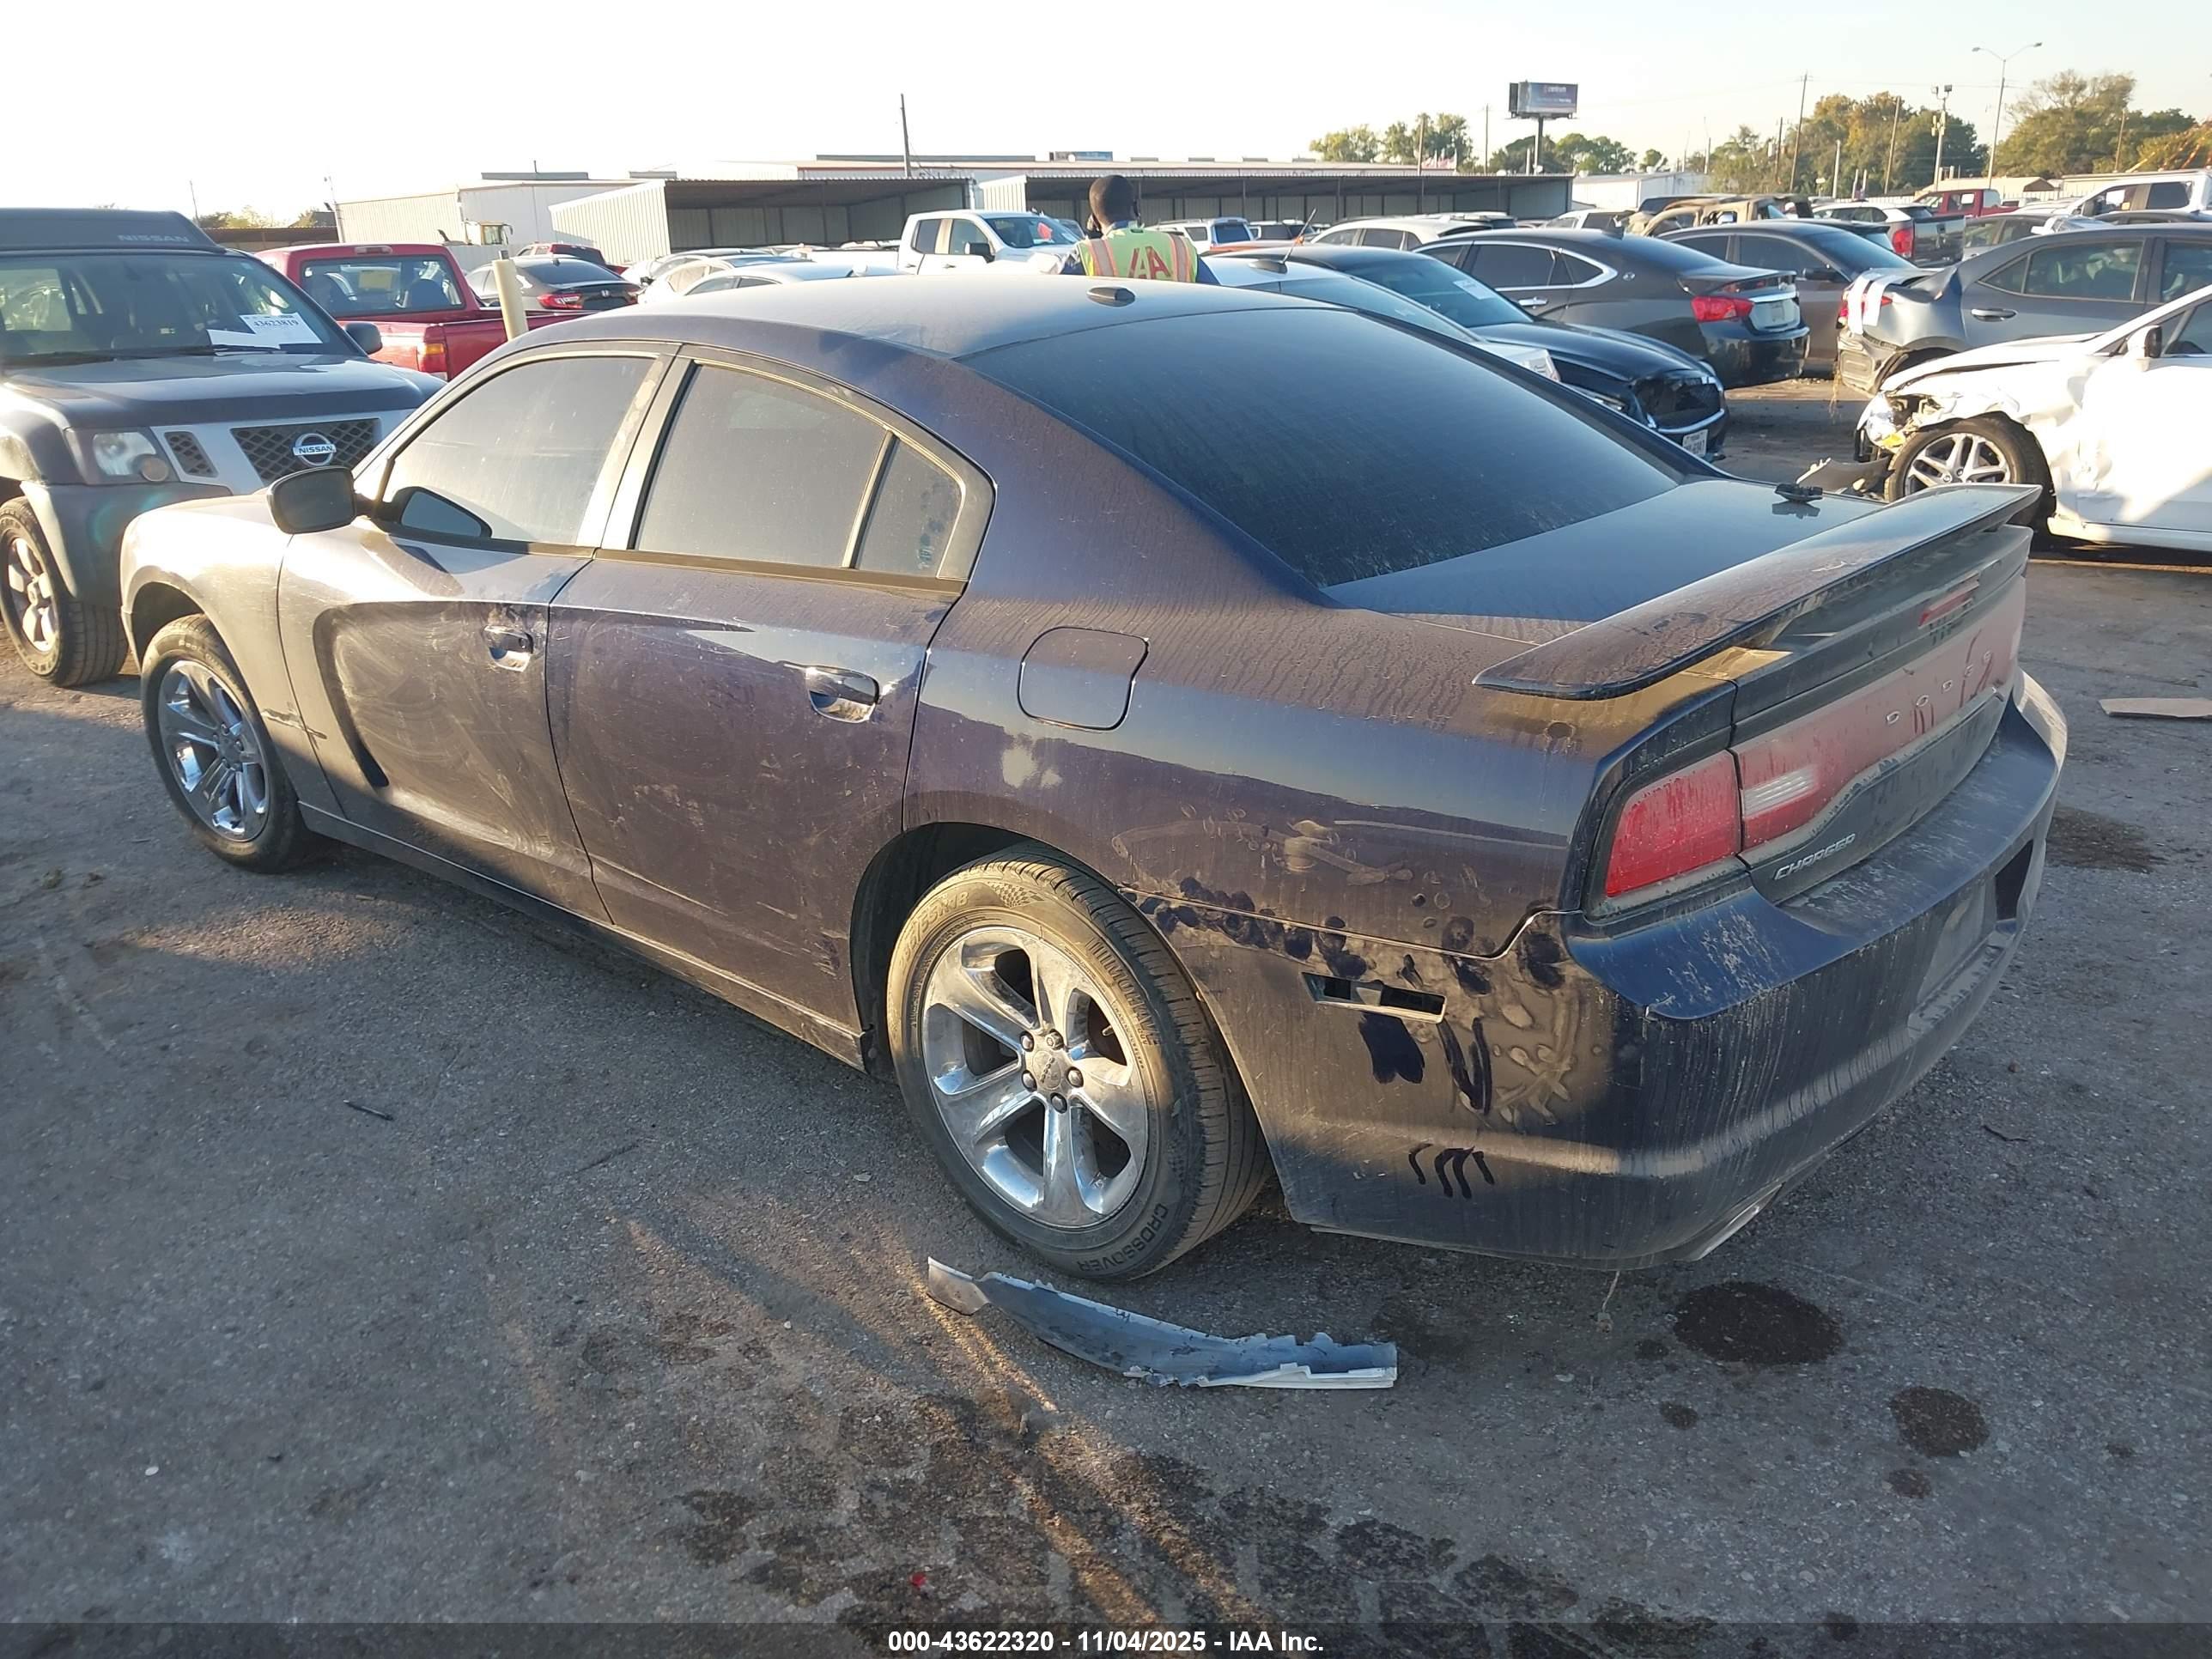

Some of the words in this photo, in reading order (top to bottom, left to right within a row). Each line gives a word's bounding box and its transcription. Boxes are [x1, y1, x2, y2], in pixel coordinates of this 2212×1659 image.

[298, 446, 333, 454] NISSAN
[1886, 650, 1992, 725] DODGE
[1773, 832, 1856, 881] CHARGER
[1077, 1203, 1169, 1272] CROSSOVER
